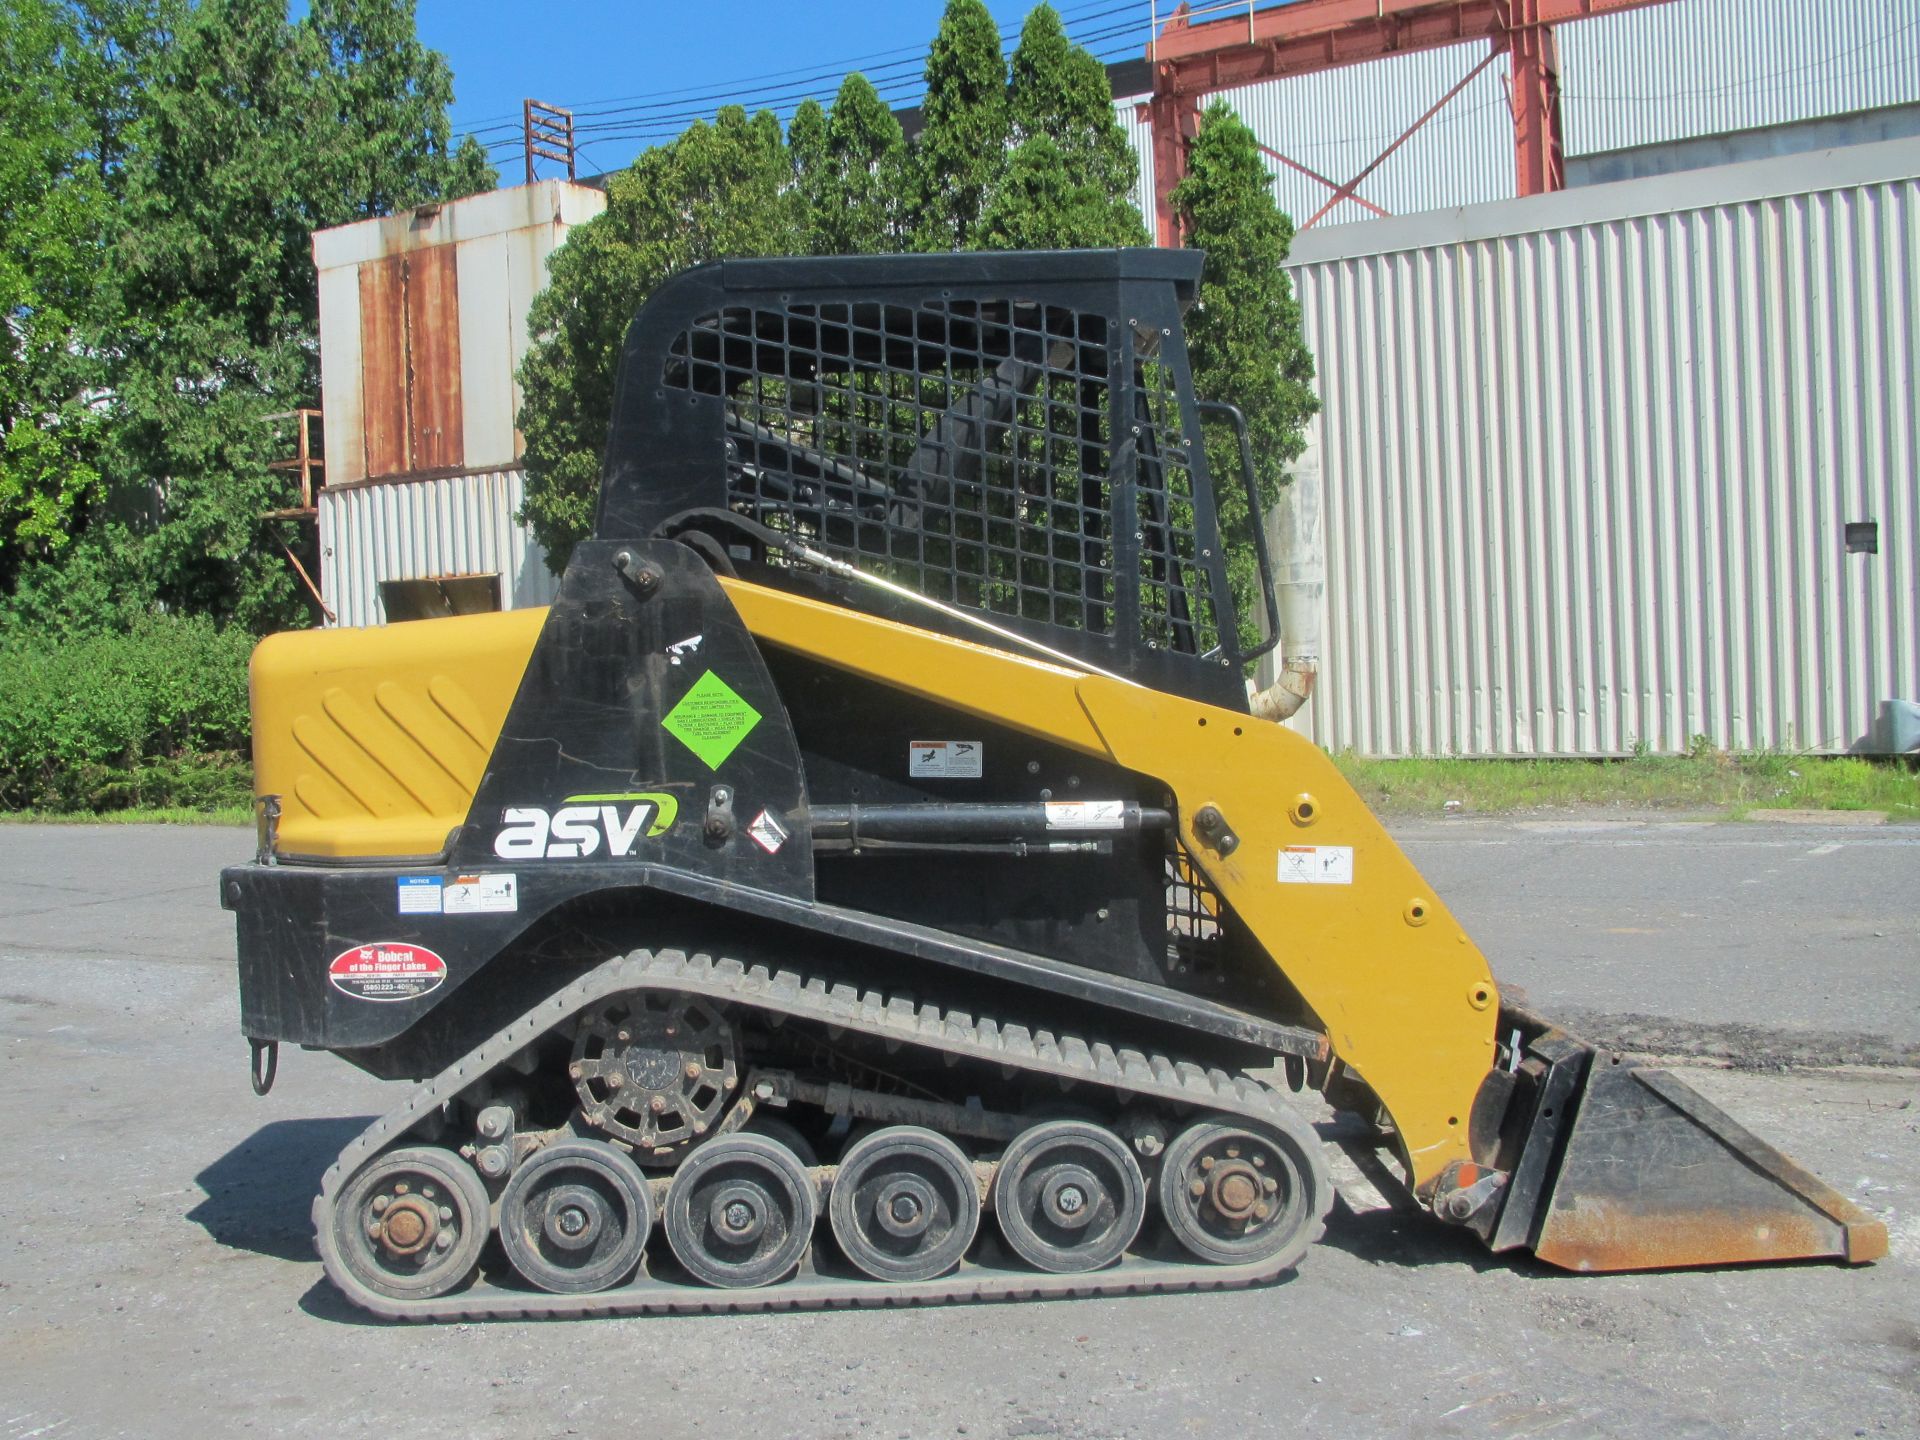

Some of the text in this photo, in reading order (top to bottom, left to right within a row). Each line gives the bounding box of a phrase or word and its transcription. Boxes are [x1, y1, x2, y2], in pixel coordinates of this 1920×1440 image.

[377, 951, 414, 962] Bobcat
[349, 962, 427, 972] of the Finger Lakes
